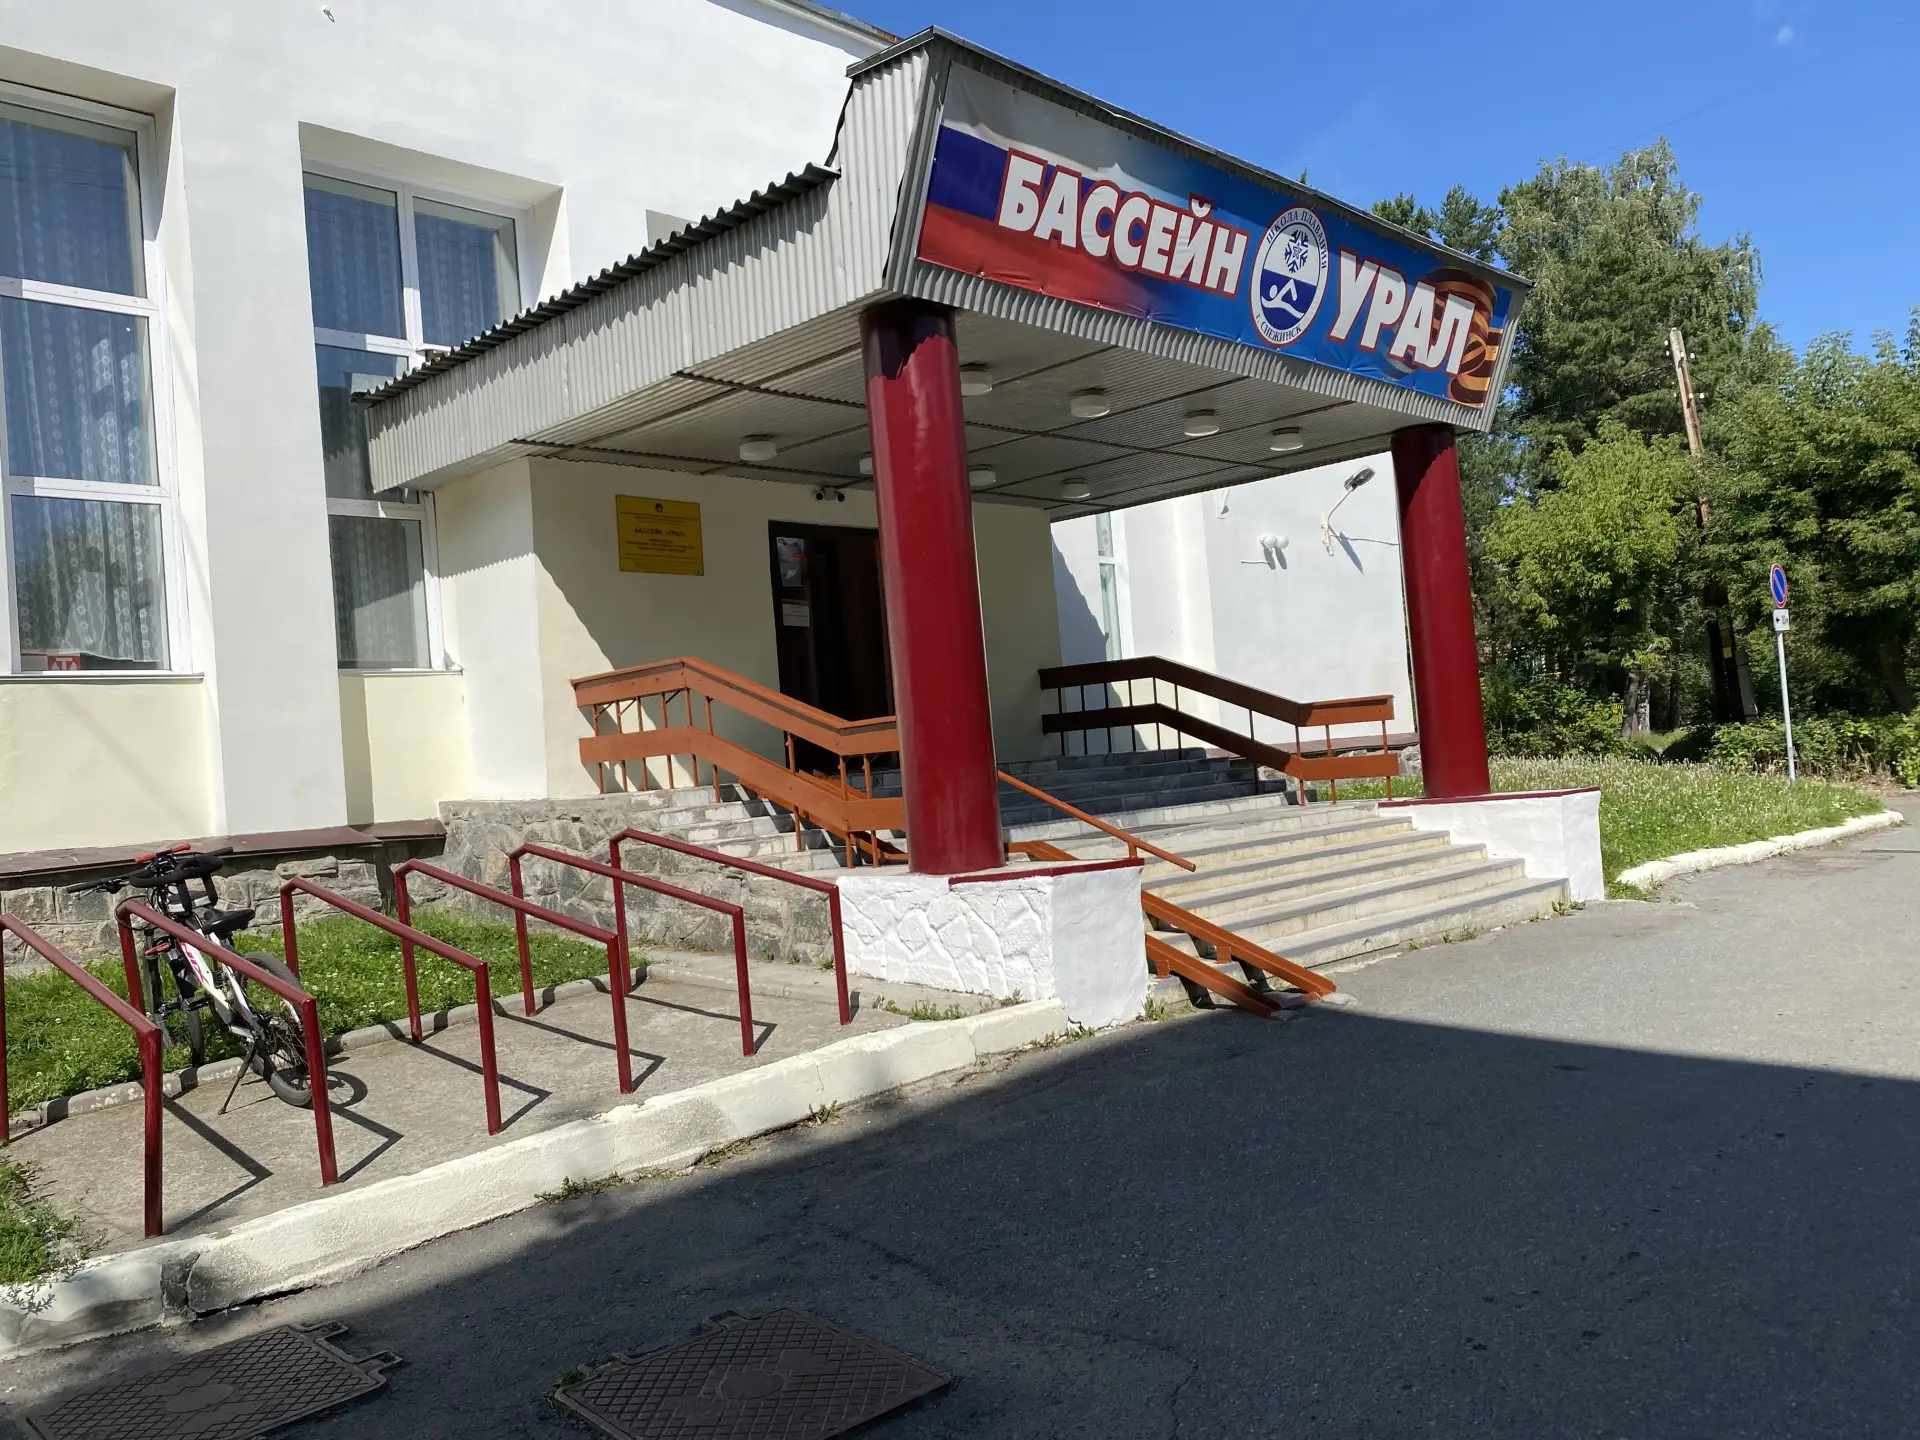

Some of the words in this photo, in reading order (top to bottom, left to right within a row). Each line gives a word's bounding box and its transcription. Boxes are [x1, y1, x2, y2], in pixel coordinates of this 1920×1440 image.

[997, 150, 1249, 296] БАССЕЙН
[1330, 250, 1477, 376] УРАЛ
[1266, 211, 1299, 244] ШКОЛА
[1300, 209, 1328, 270] ПЛАВАНИЯ
[1260, 321, 1303, 343] СНЕЖИНСК
